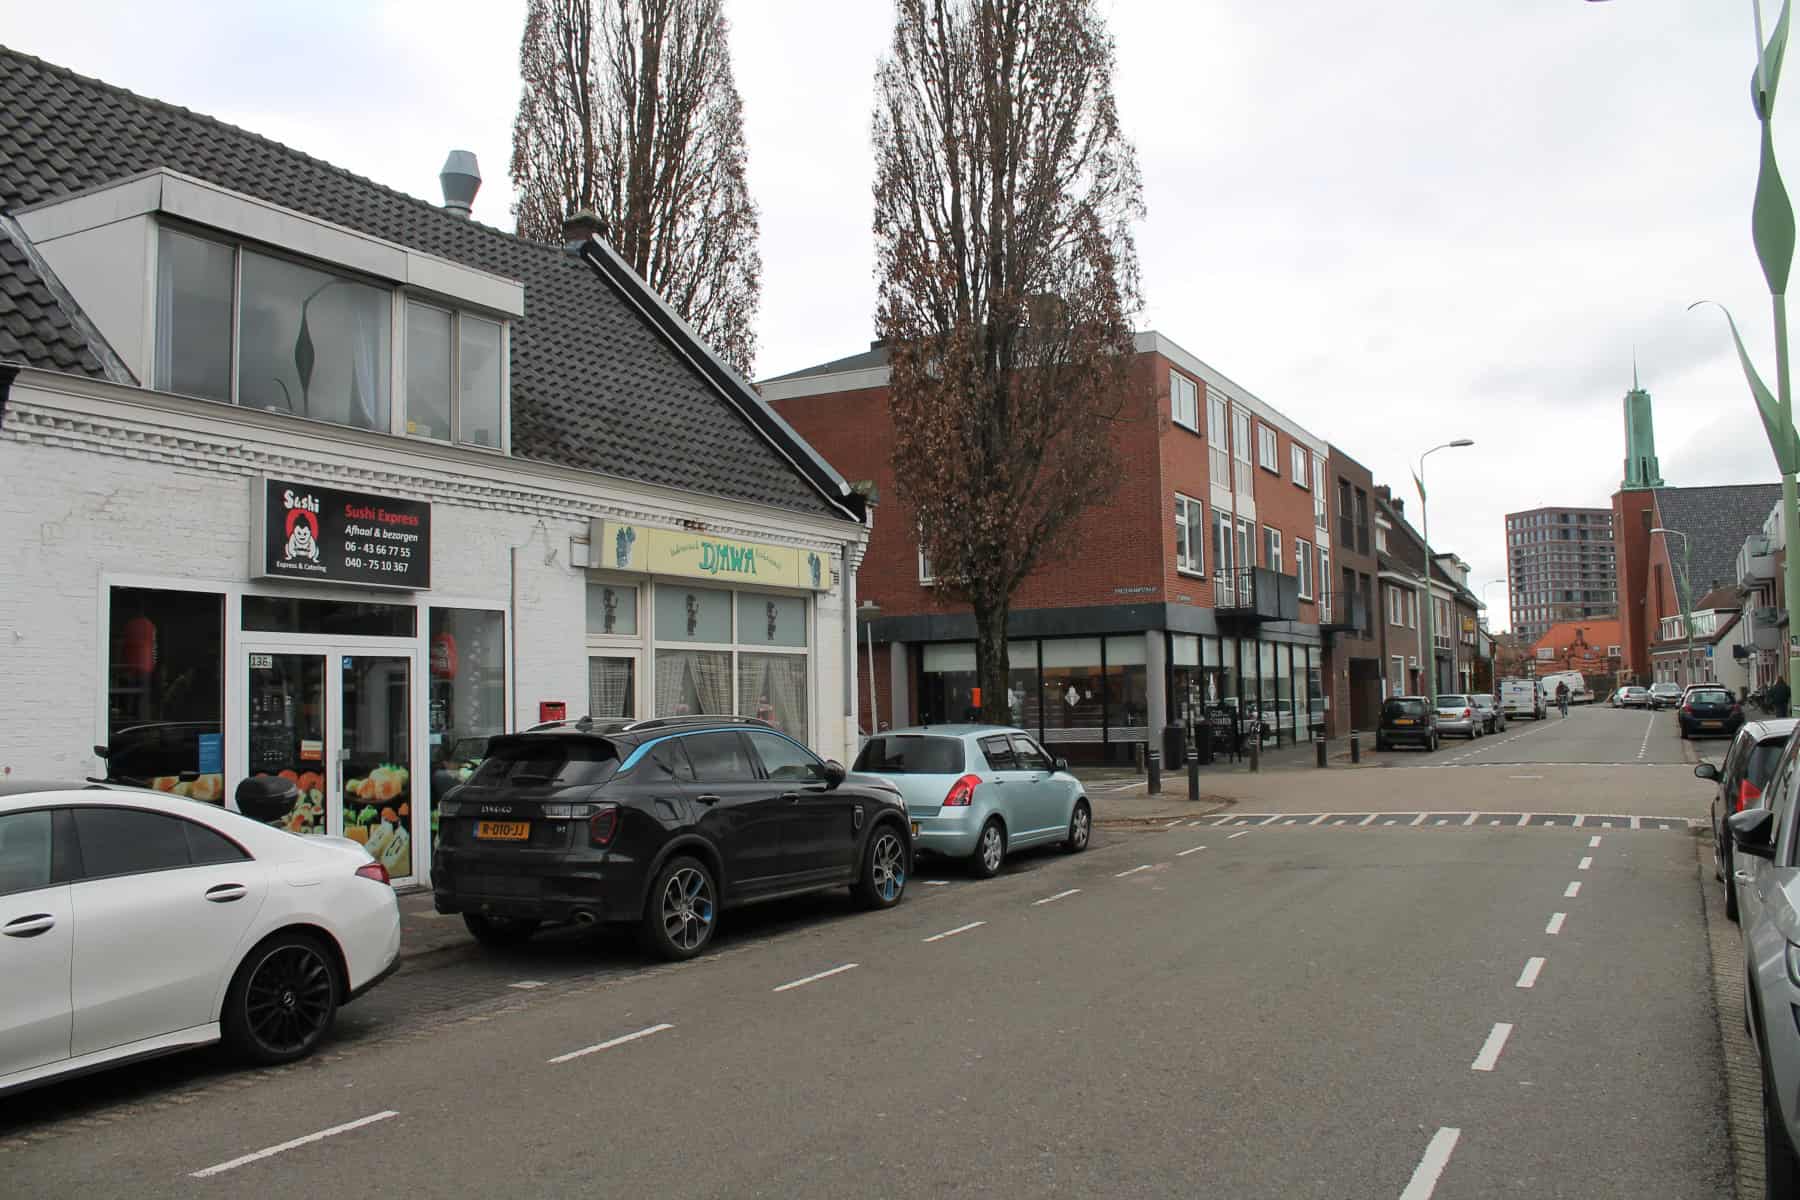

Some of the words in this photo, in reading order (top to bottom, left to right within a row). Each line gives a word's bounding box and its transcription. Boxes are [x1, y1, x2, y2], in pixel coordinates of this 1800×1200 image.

[283, 489, 319, 513] Sushi
[345, 505, 375, 521] Sushi
[378, 509, 419, 526] Express
[345, 525, 373, 537] Afhaal
[374, 528, 381, 537] &
[383, 529, 418, 543] bezorgen
[345, 541, 357, 551] 06
[363, 543, 375, 553] 43
[376, 545, 387, 554] 66
[388, 546, 398, 556] 77
[400, 547, 411, 557] 55
[276, 560, 297, 569] Express
[304, 563, 328, 573] Catering
[345, 557, 361, 568] 040
[369, 559, 379, 569] 75
[382, 561, 391, 571] 10
[393, 562, 409, 573] 367
